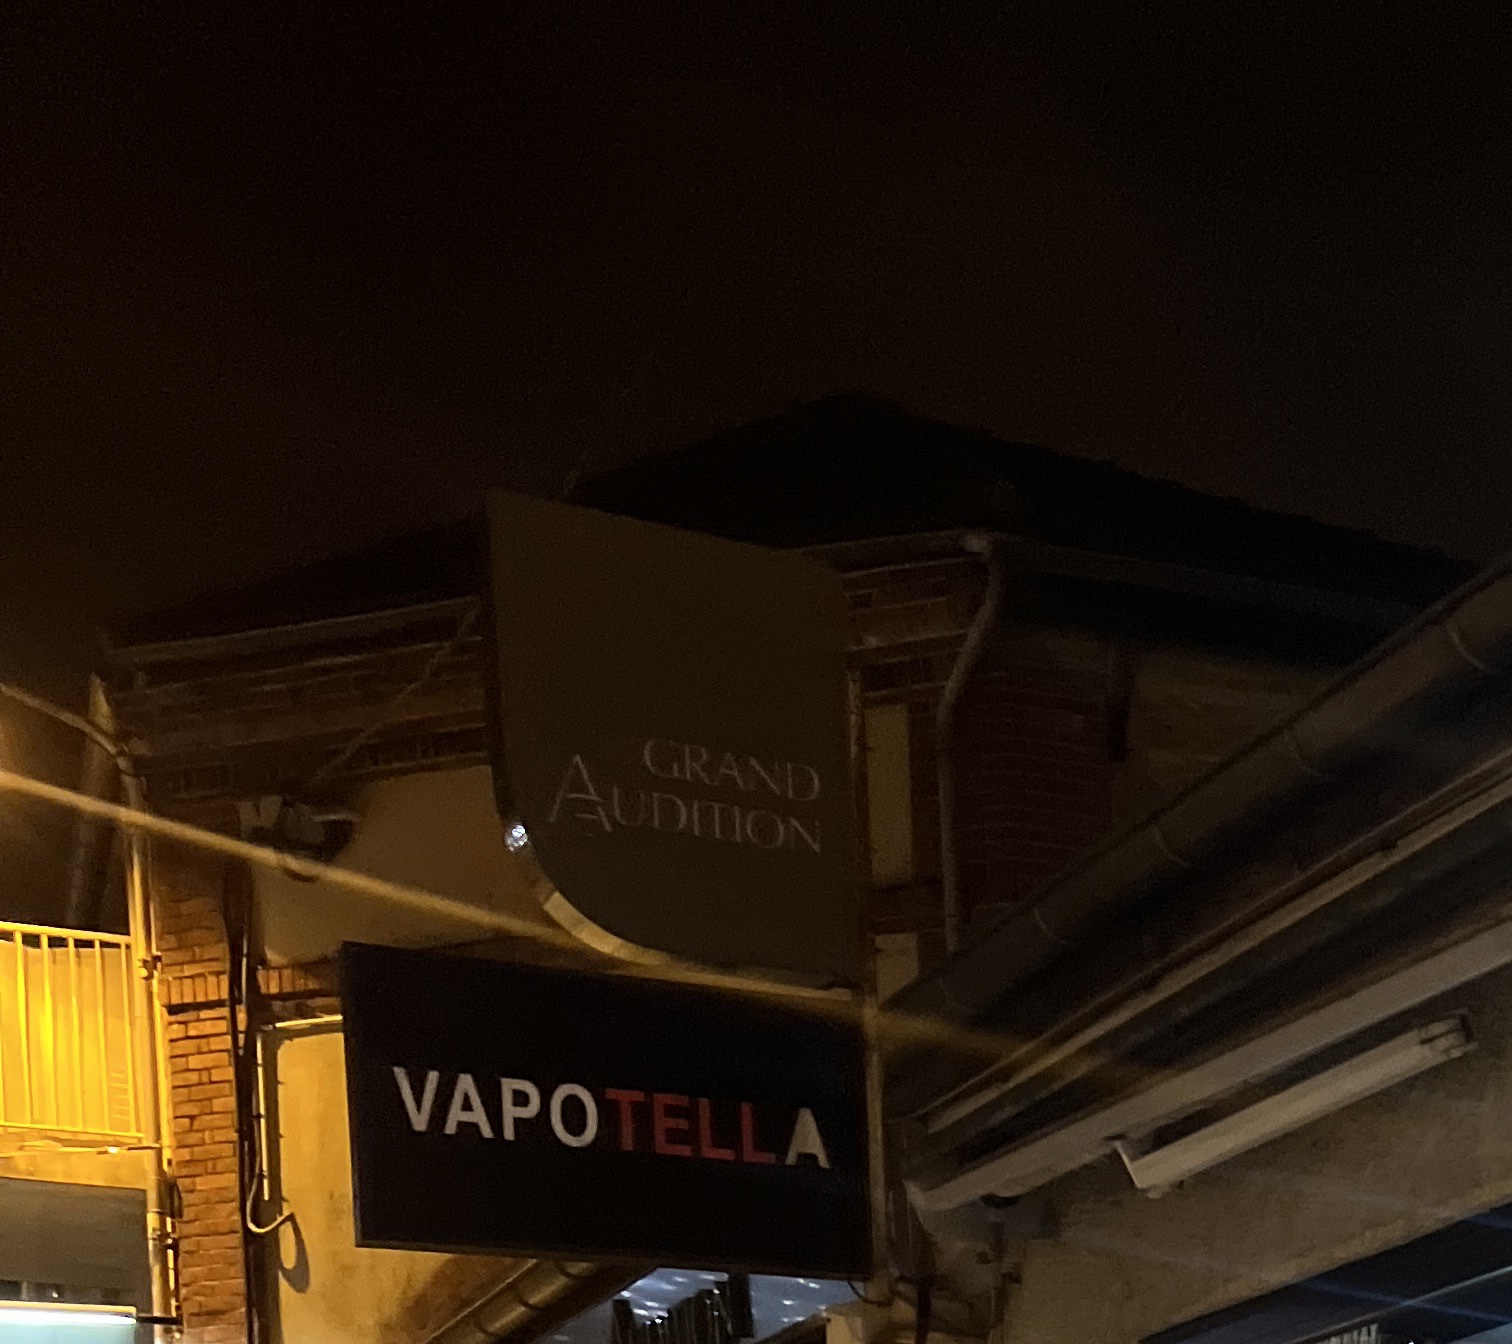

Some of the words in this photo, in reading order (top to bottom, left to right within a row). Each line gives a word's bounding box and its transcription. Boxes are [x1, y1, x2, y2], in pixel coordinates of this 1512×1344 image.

[548, 753, 822, 855] AUDITION
[643, 737, 820, 802] GRAND
[391, 1065, 832, 1170] VAPOTELLA
